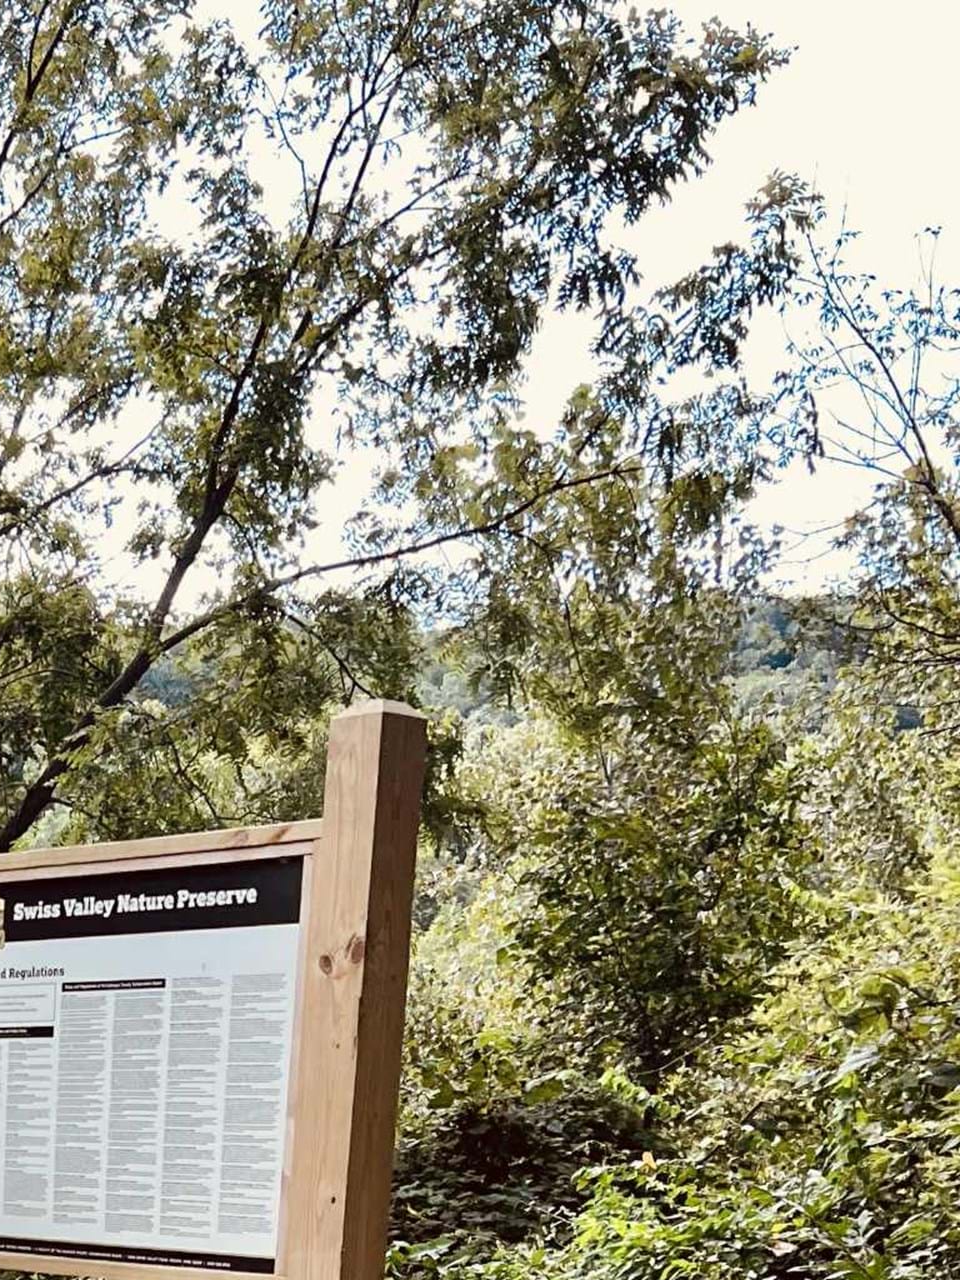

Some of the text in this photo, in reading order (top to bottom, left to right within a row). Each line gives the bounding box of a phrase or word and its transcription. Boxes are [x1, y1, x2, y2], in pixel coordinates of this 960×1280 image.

[13, 888, 258, 921] Swiss Valley Nature Preserve
[8, 966, 65, 981] Regulations
